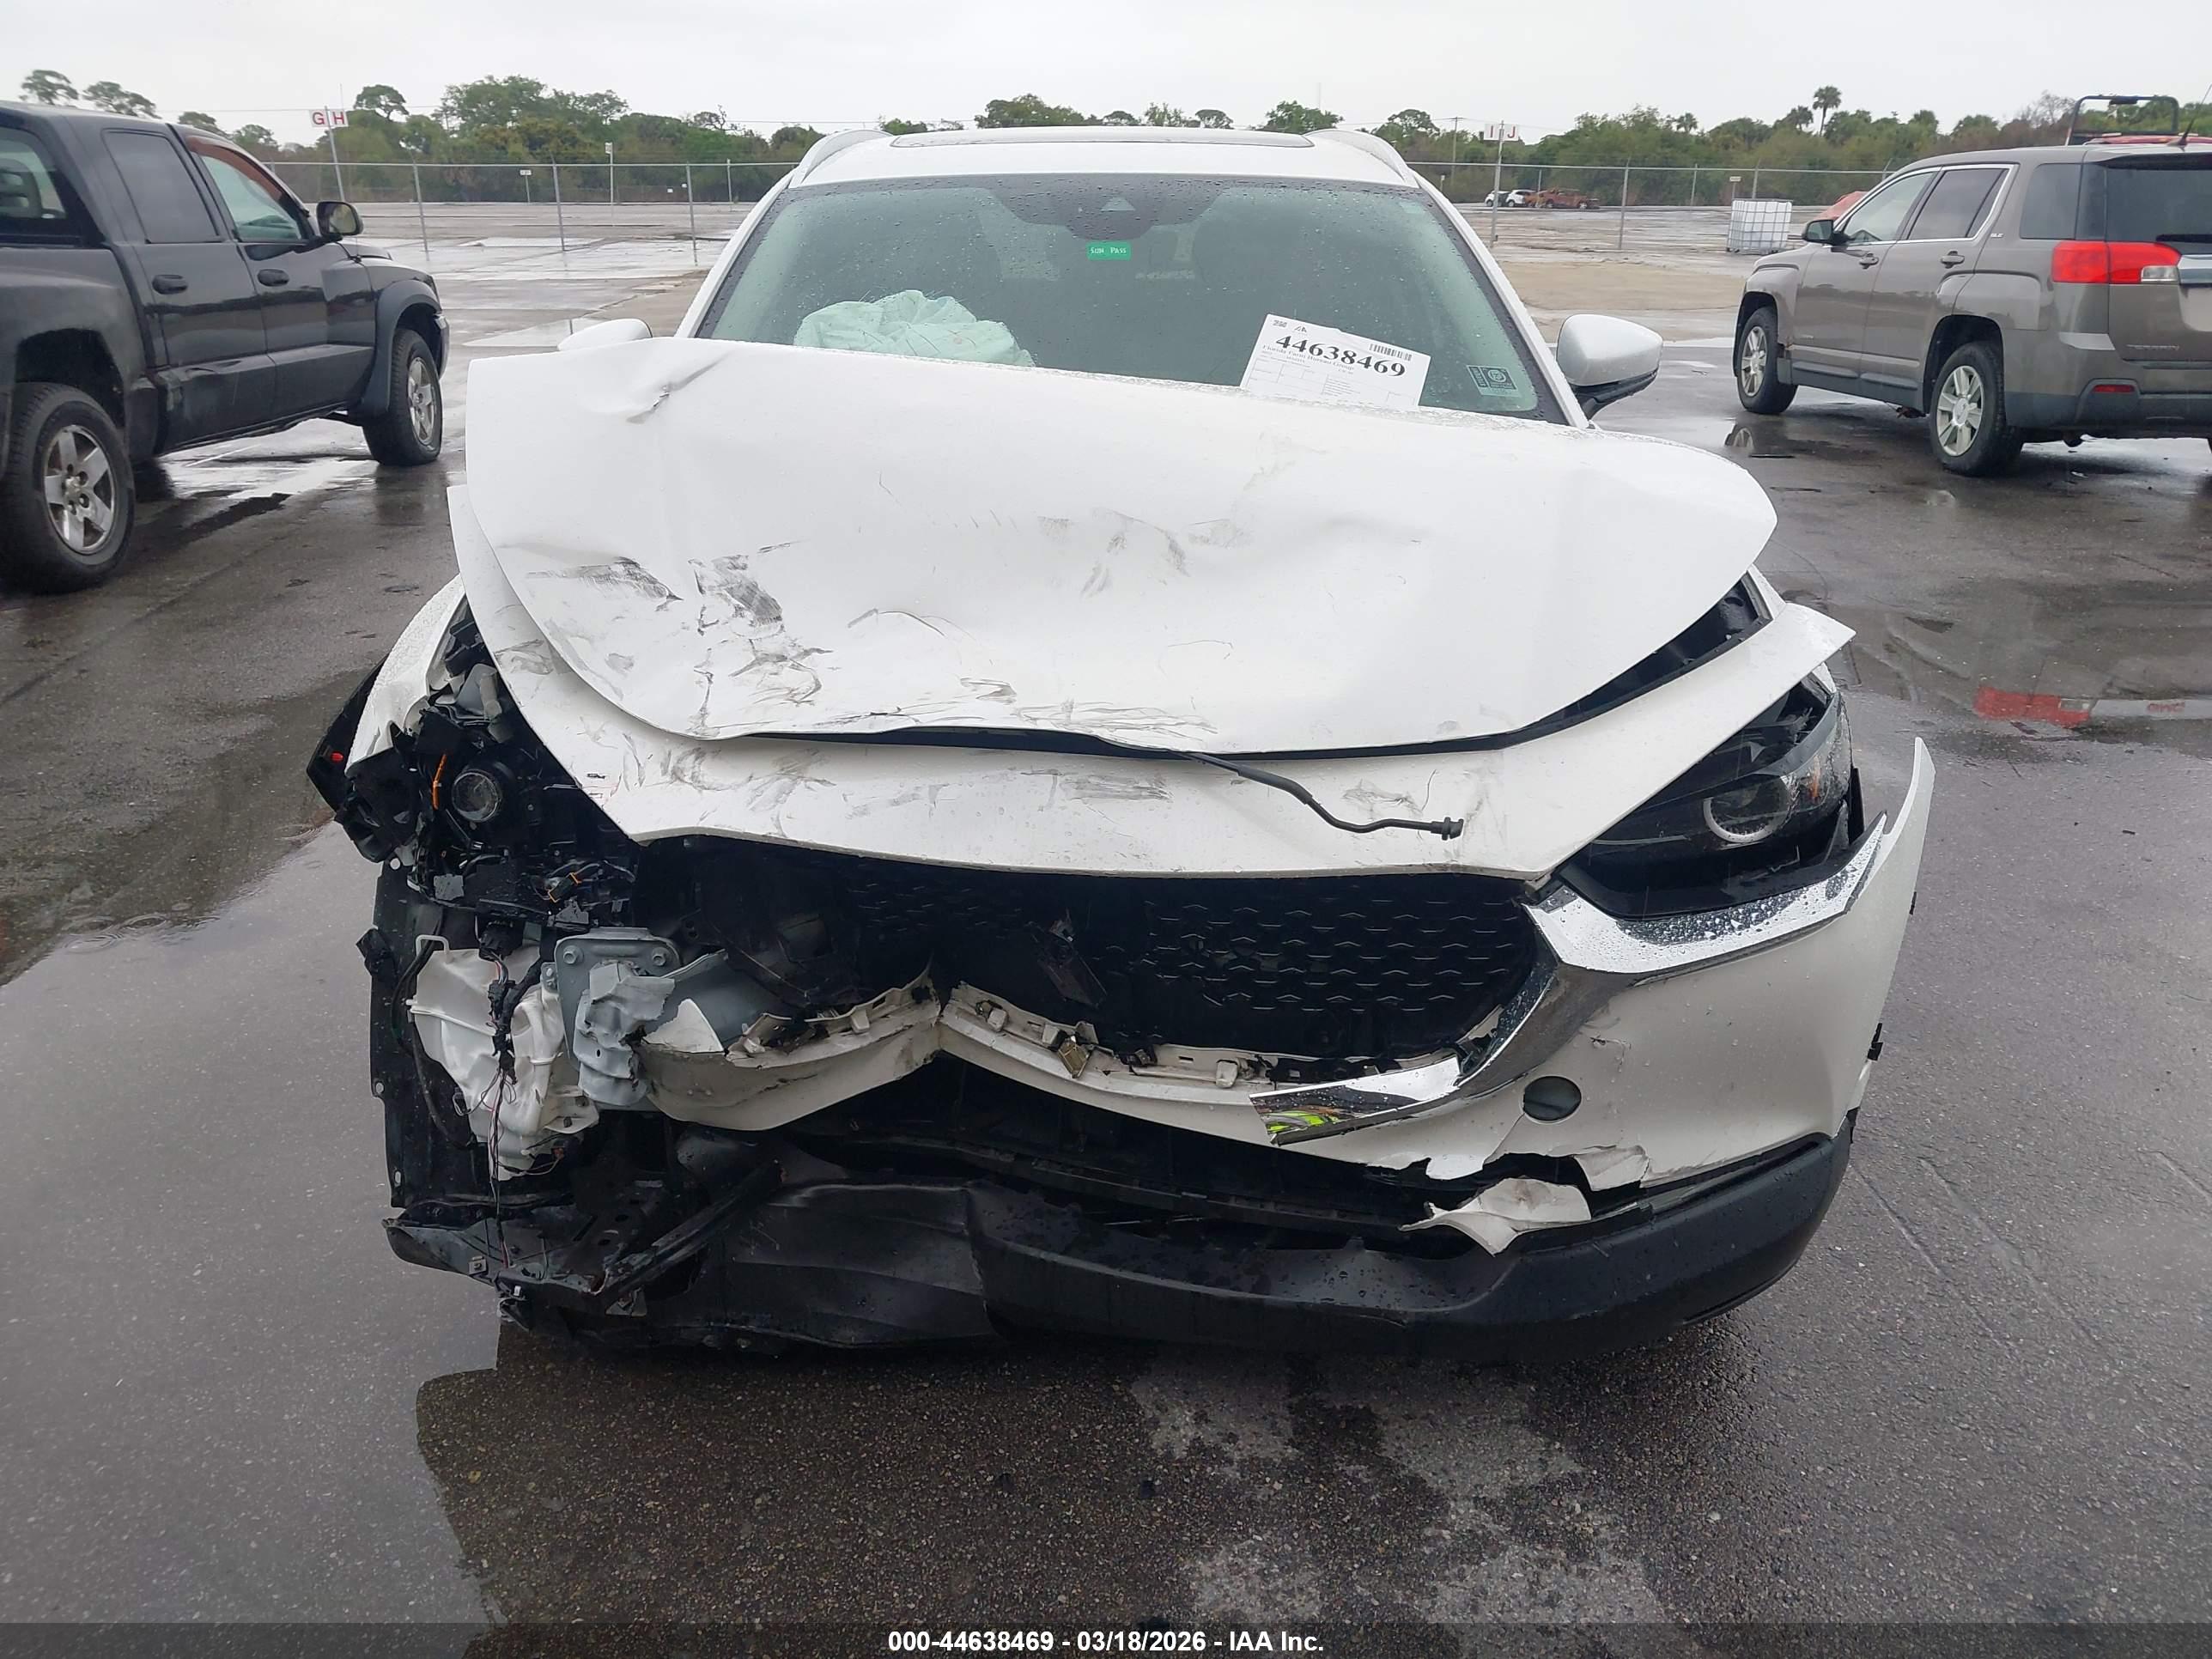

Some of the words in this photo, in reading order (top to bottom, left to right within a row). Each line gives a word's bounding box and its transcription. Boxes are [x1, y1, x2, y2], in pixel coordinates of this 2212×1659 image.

[312, 112, 325, 125] G
[332, 111, 345, 125] H
[1506, 125, 1516, 139] J
[1275, 335, 1406, 377] 44638469
